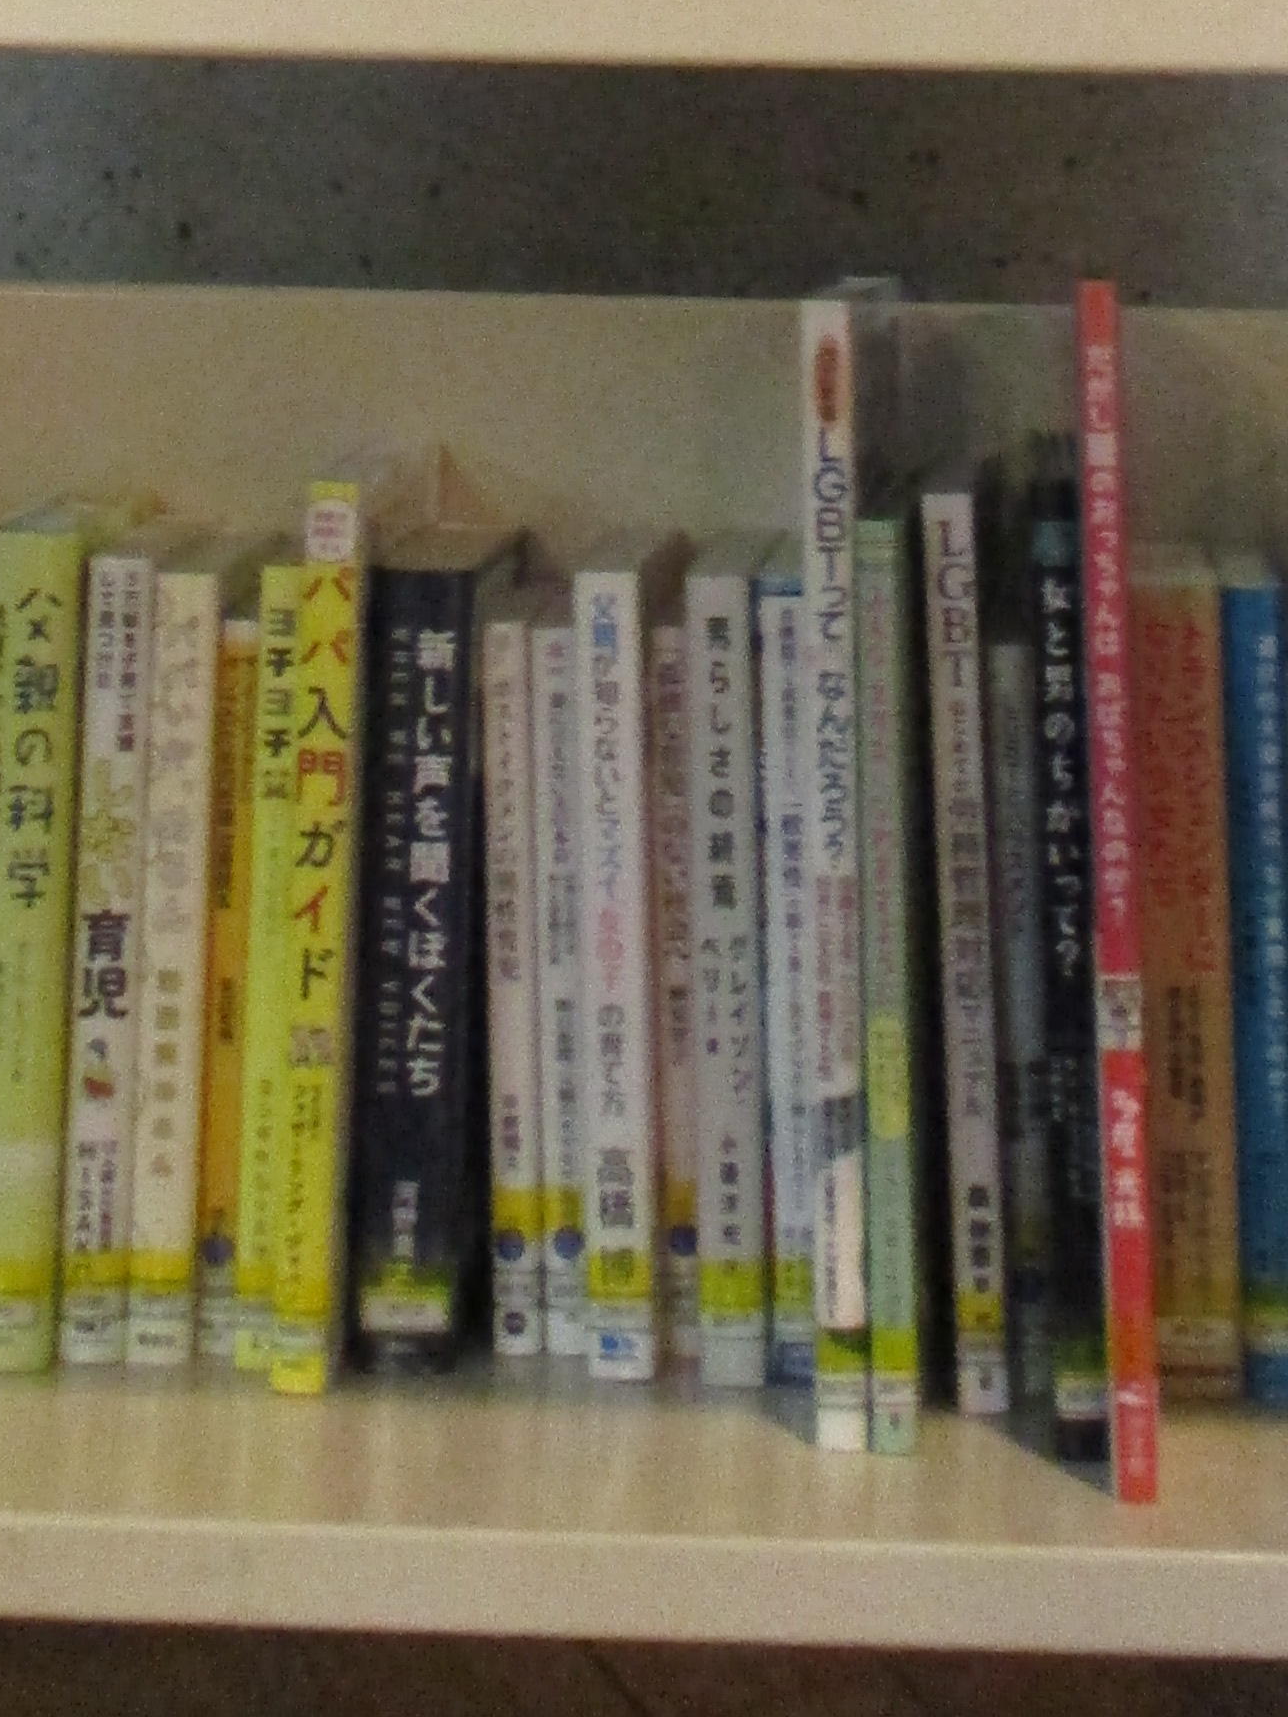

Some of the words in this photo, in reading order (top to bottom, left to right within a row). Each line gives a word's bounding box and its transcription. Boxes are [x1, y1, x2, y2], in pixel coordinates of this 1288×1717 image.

[3, 585, 66, 910] 父親の科学
[292, 571, 355, 1005] パパ入門ガイド
[405, 627, 461, 1102] 新しい声を聞くぼくたち
[1040, 577, 1085, 980] 女と男のちがいって？
